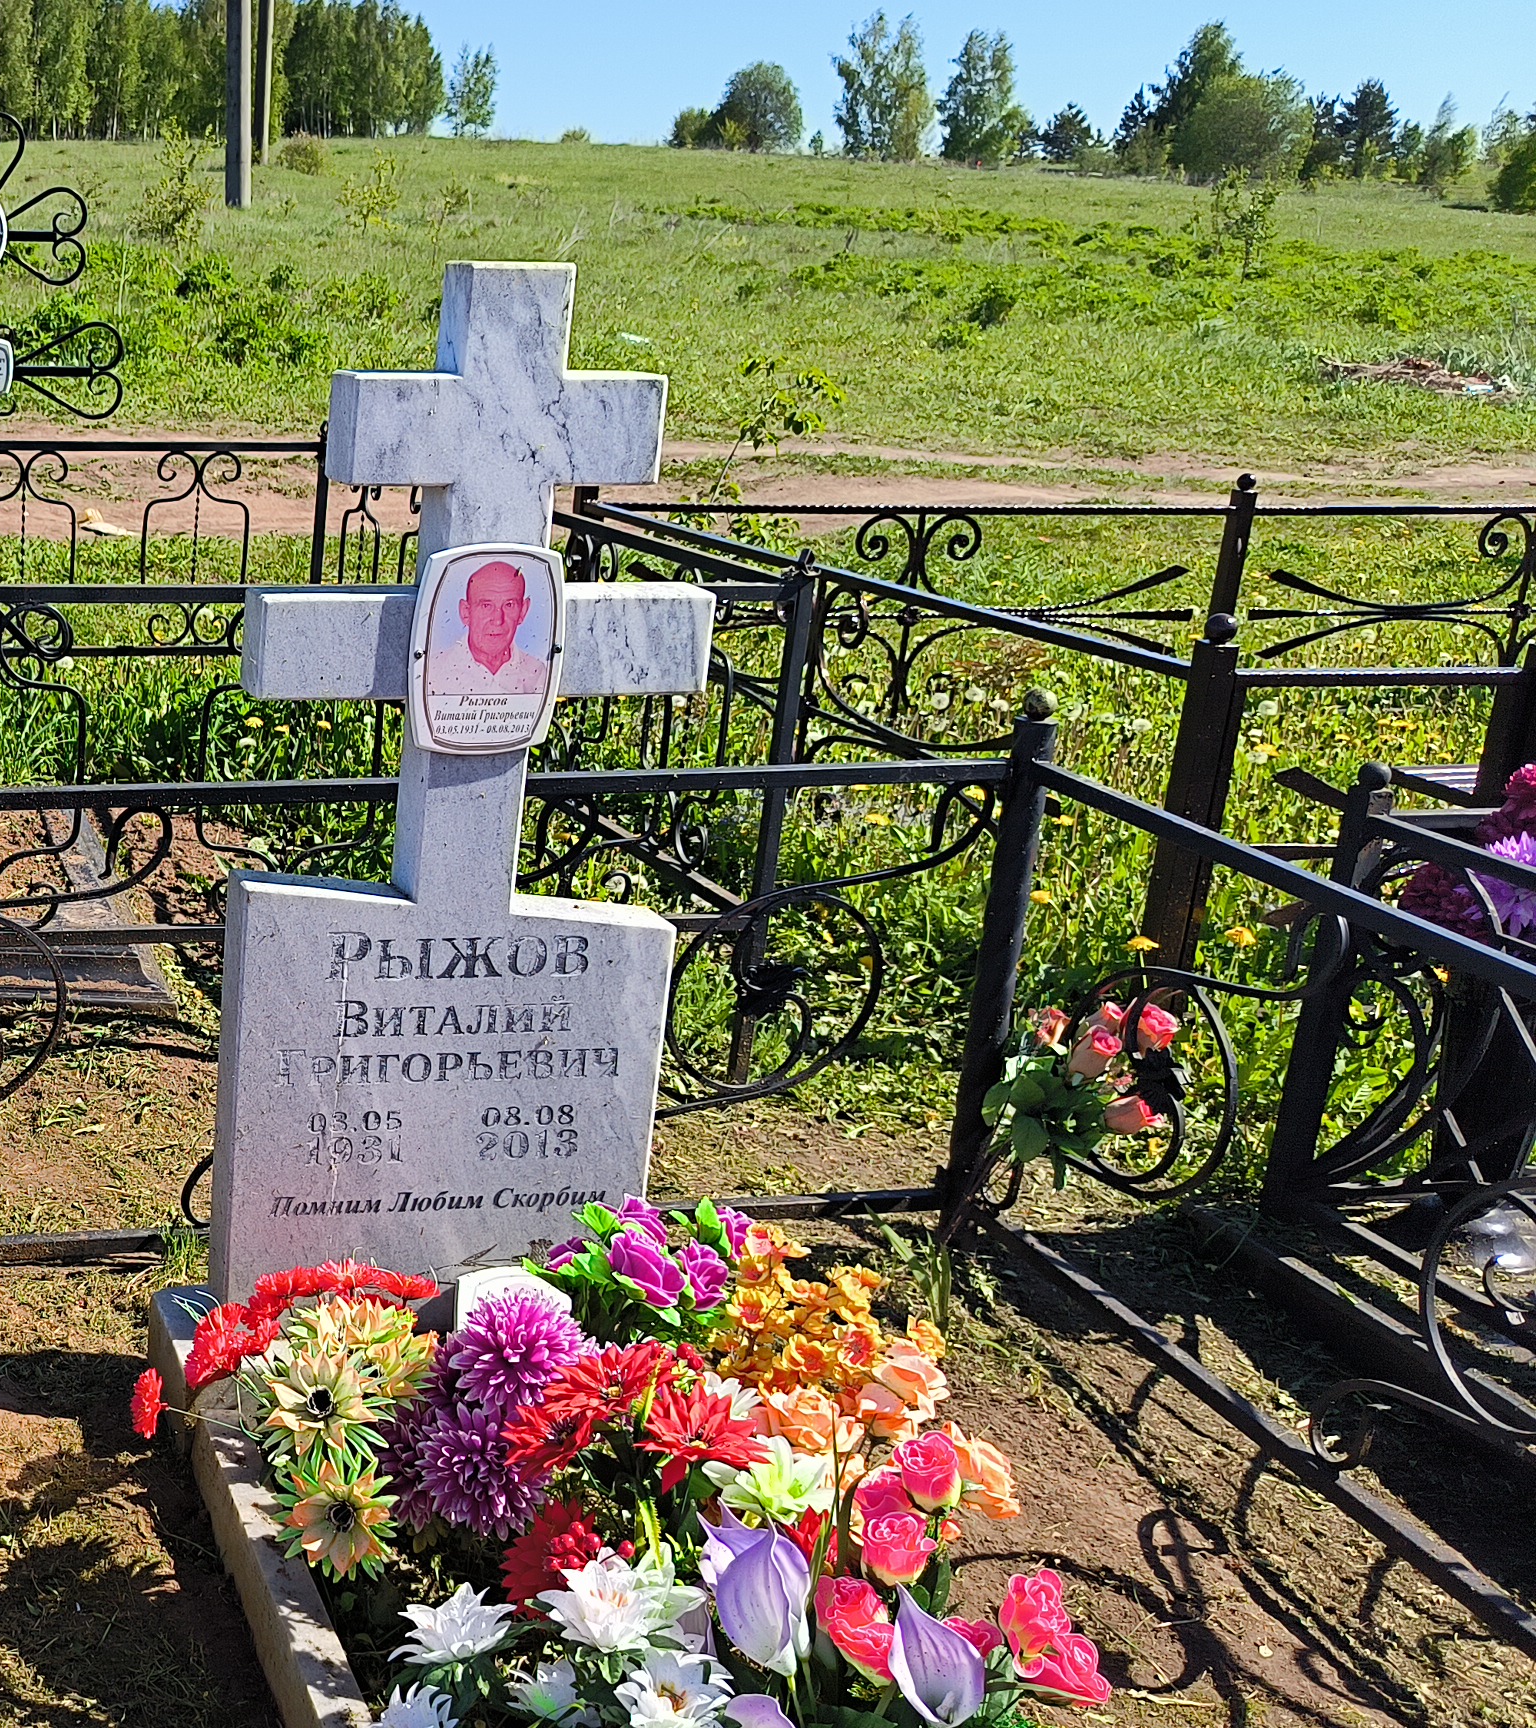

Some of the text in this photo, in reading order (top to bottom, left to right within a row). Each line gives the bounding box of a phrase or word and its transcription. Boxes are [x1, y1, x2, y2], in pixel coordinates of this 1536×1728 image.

[434, 710, 535, 723] Виталий Григорьевич
[459, 696, 508, 706] Рыжов
[436, 724, 479, 735] 03.05.1931
[486, 724, 530, 734] 08.08.2013
[325, 930, 590, 983] РЫЖОВ
[333, 996, 574, 1038] ВИТАЛИЙ
[274, 1048, 619, 1087] ГРИГОРЬЕВИЧ
[307, 1110, 402, 1133] 03.05
[481, 1104, 575, 1127] 08.08
[305, 1134, 404, 1167] 1931
[475, 1129, 578, 1161] 2013
[268, 1186, 606, 1218] Помним Любим Скорбим
